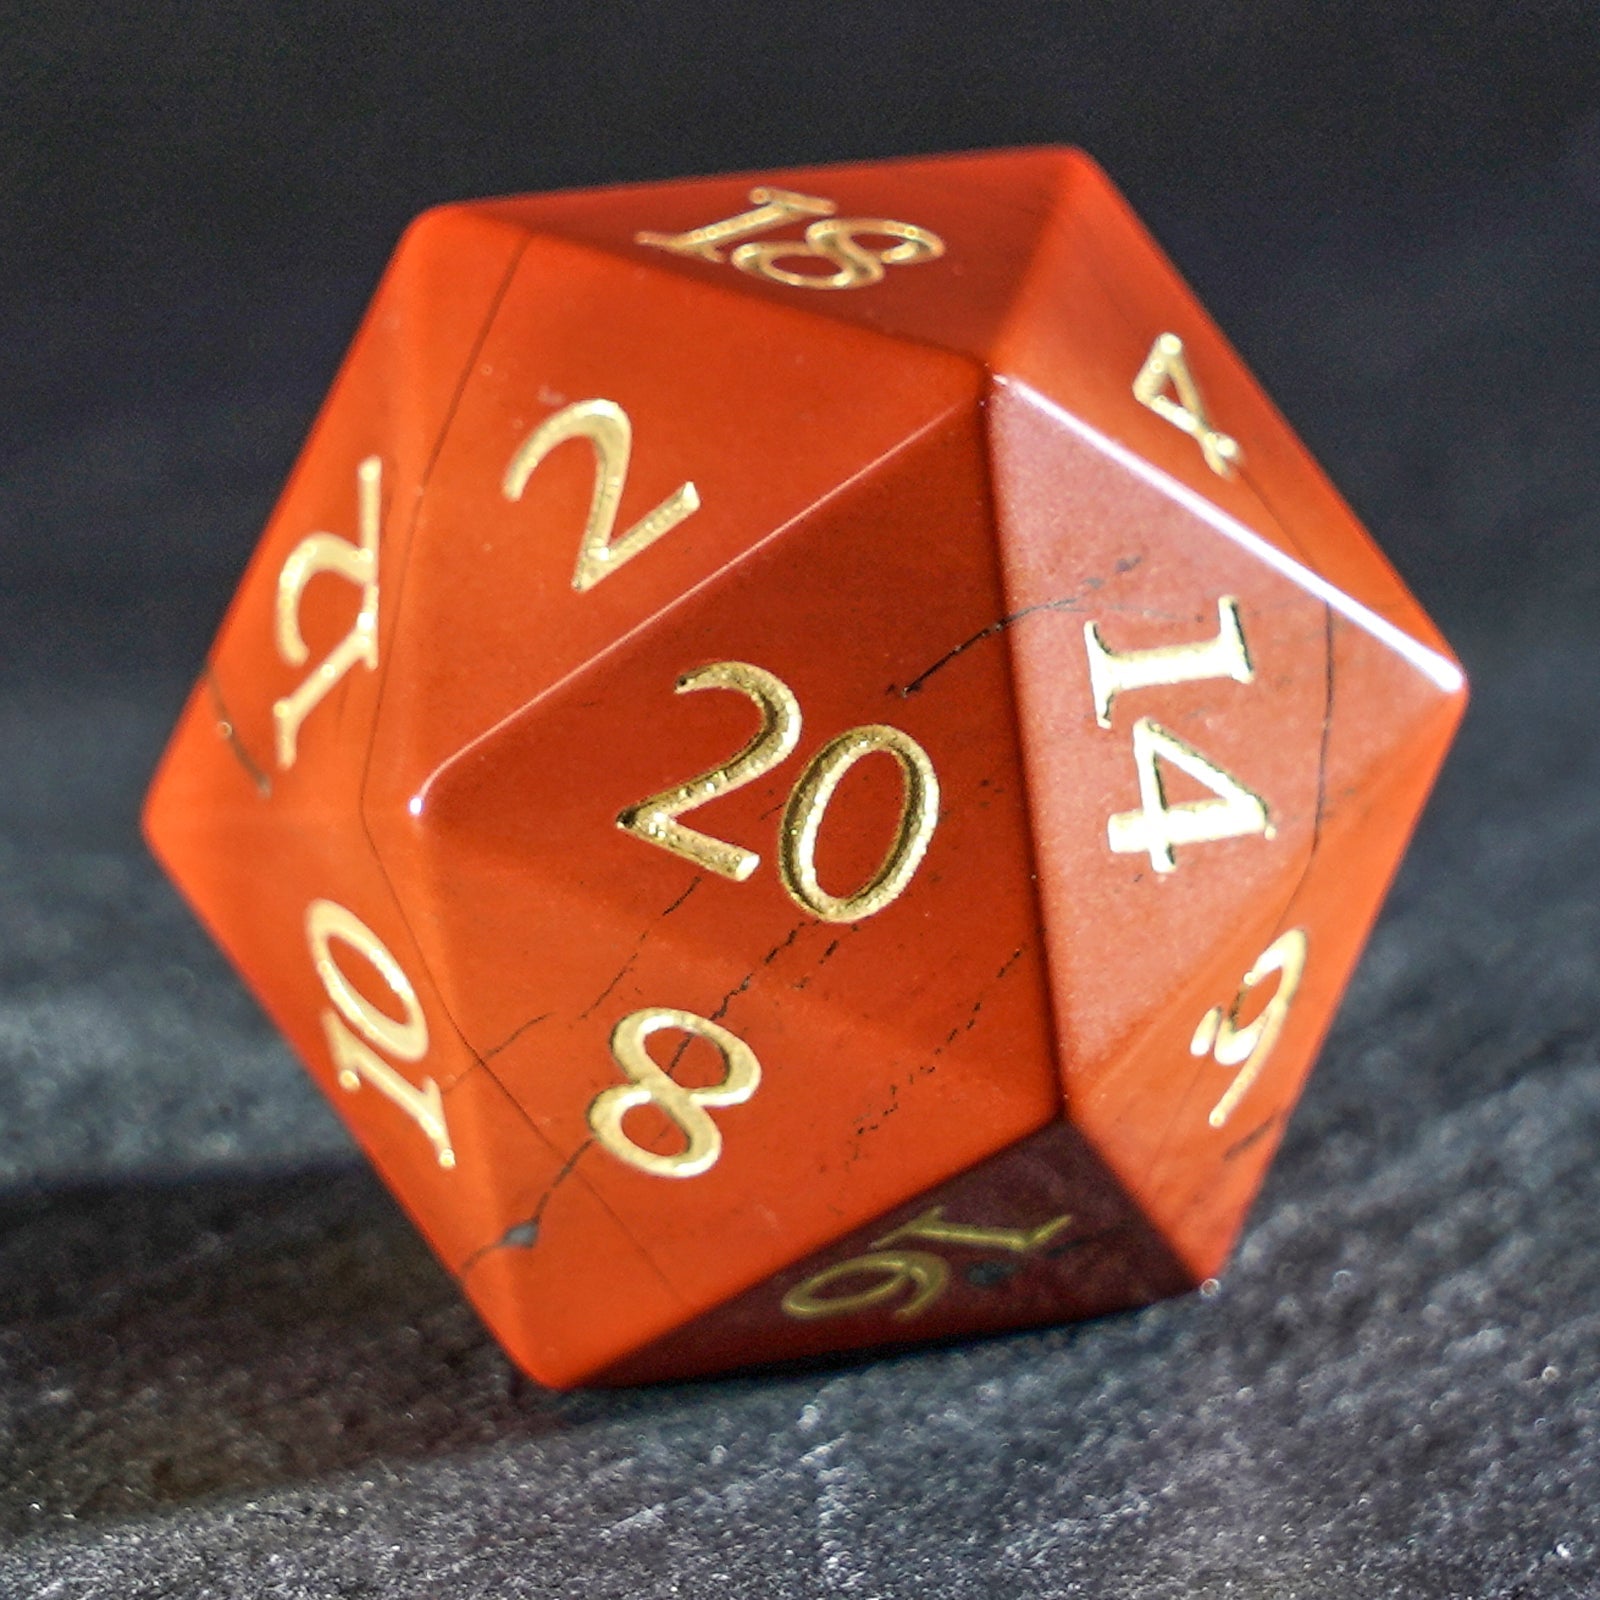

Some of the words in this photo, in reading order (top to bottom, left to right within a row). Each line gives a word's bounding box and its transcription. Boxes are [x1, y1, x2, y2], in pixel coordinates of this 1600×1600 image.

[635, 187, 946, 290] 18
[502, 398, 701, 592] 2
[1132, 332, 1241, 478] 4
[272, 455, 383, 771] 12
[616, 661, 940, 923] 20
[1083, 595, 1277, 874] 14
[304, 898, 456, 1170] 10
[585, 1006, 762, 1179] 8
